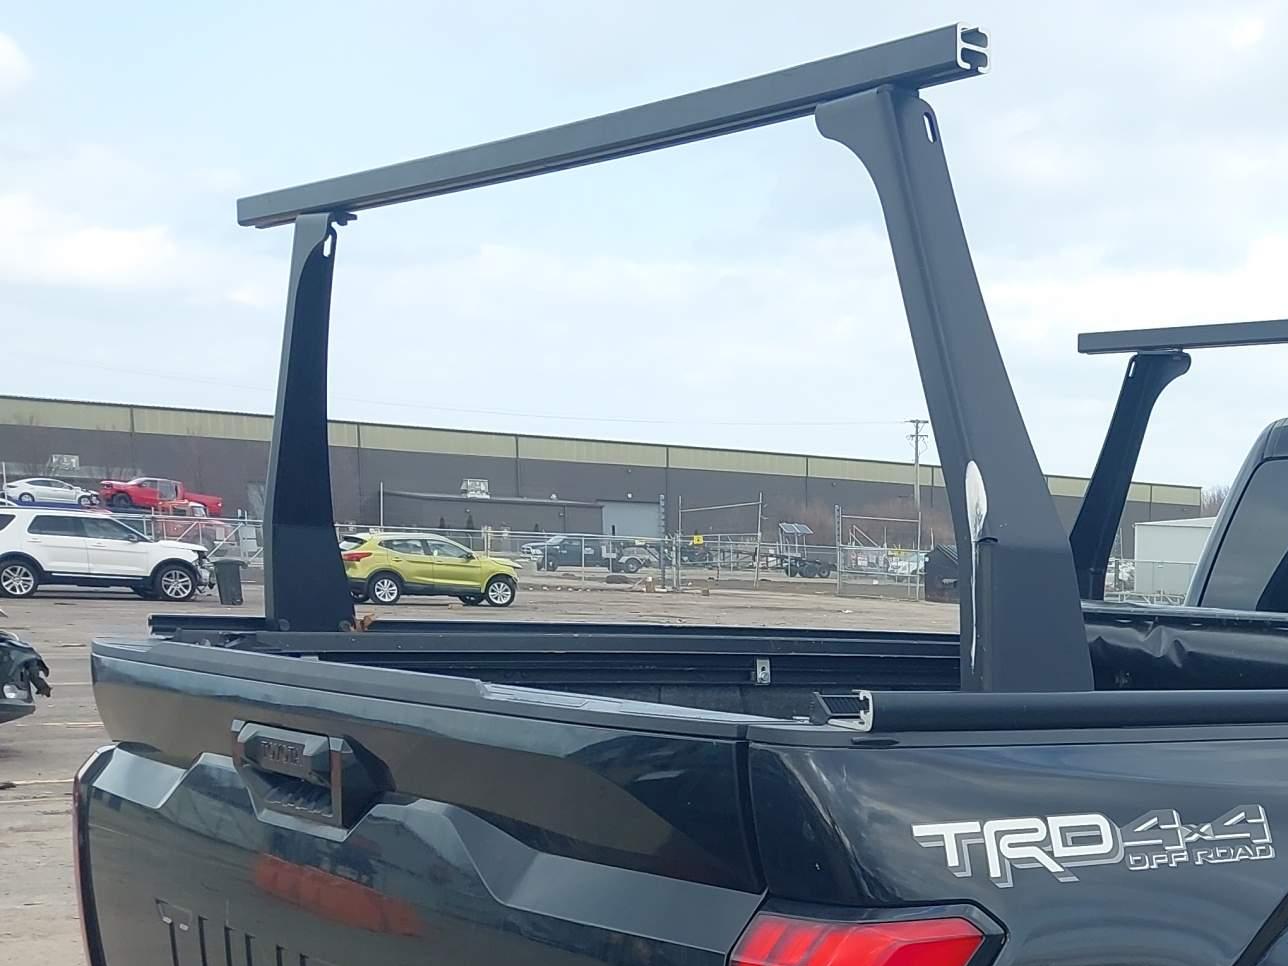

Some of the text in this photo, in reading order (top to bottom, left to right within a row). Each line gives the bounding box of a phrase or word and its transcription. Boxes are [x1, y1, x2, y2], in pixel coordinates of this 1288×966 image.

[911, 803, 1275, 889] TRD 4x4
[1124, 843, 1276, 872] OFF ROAD
